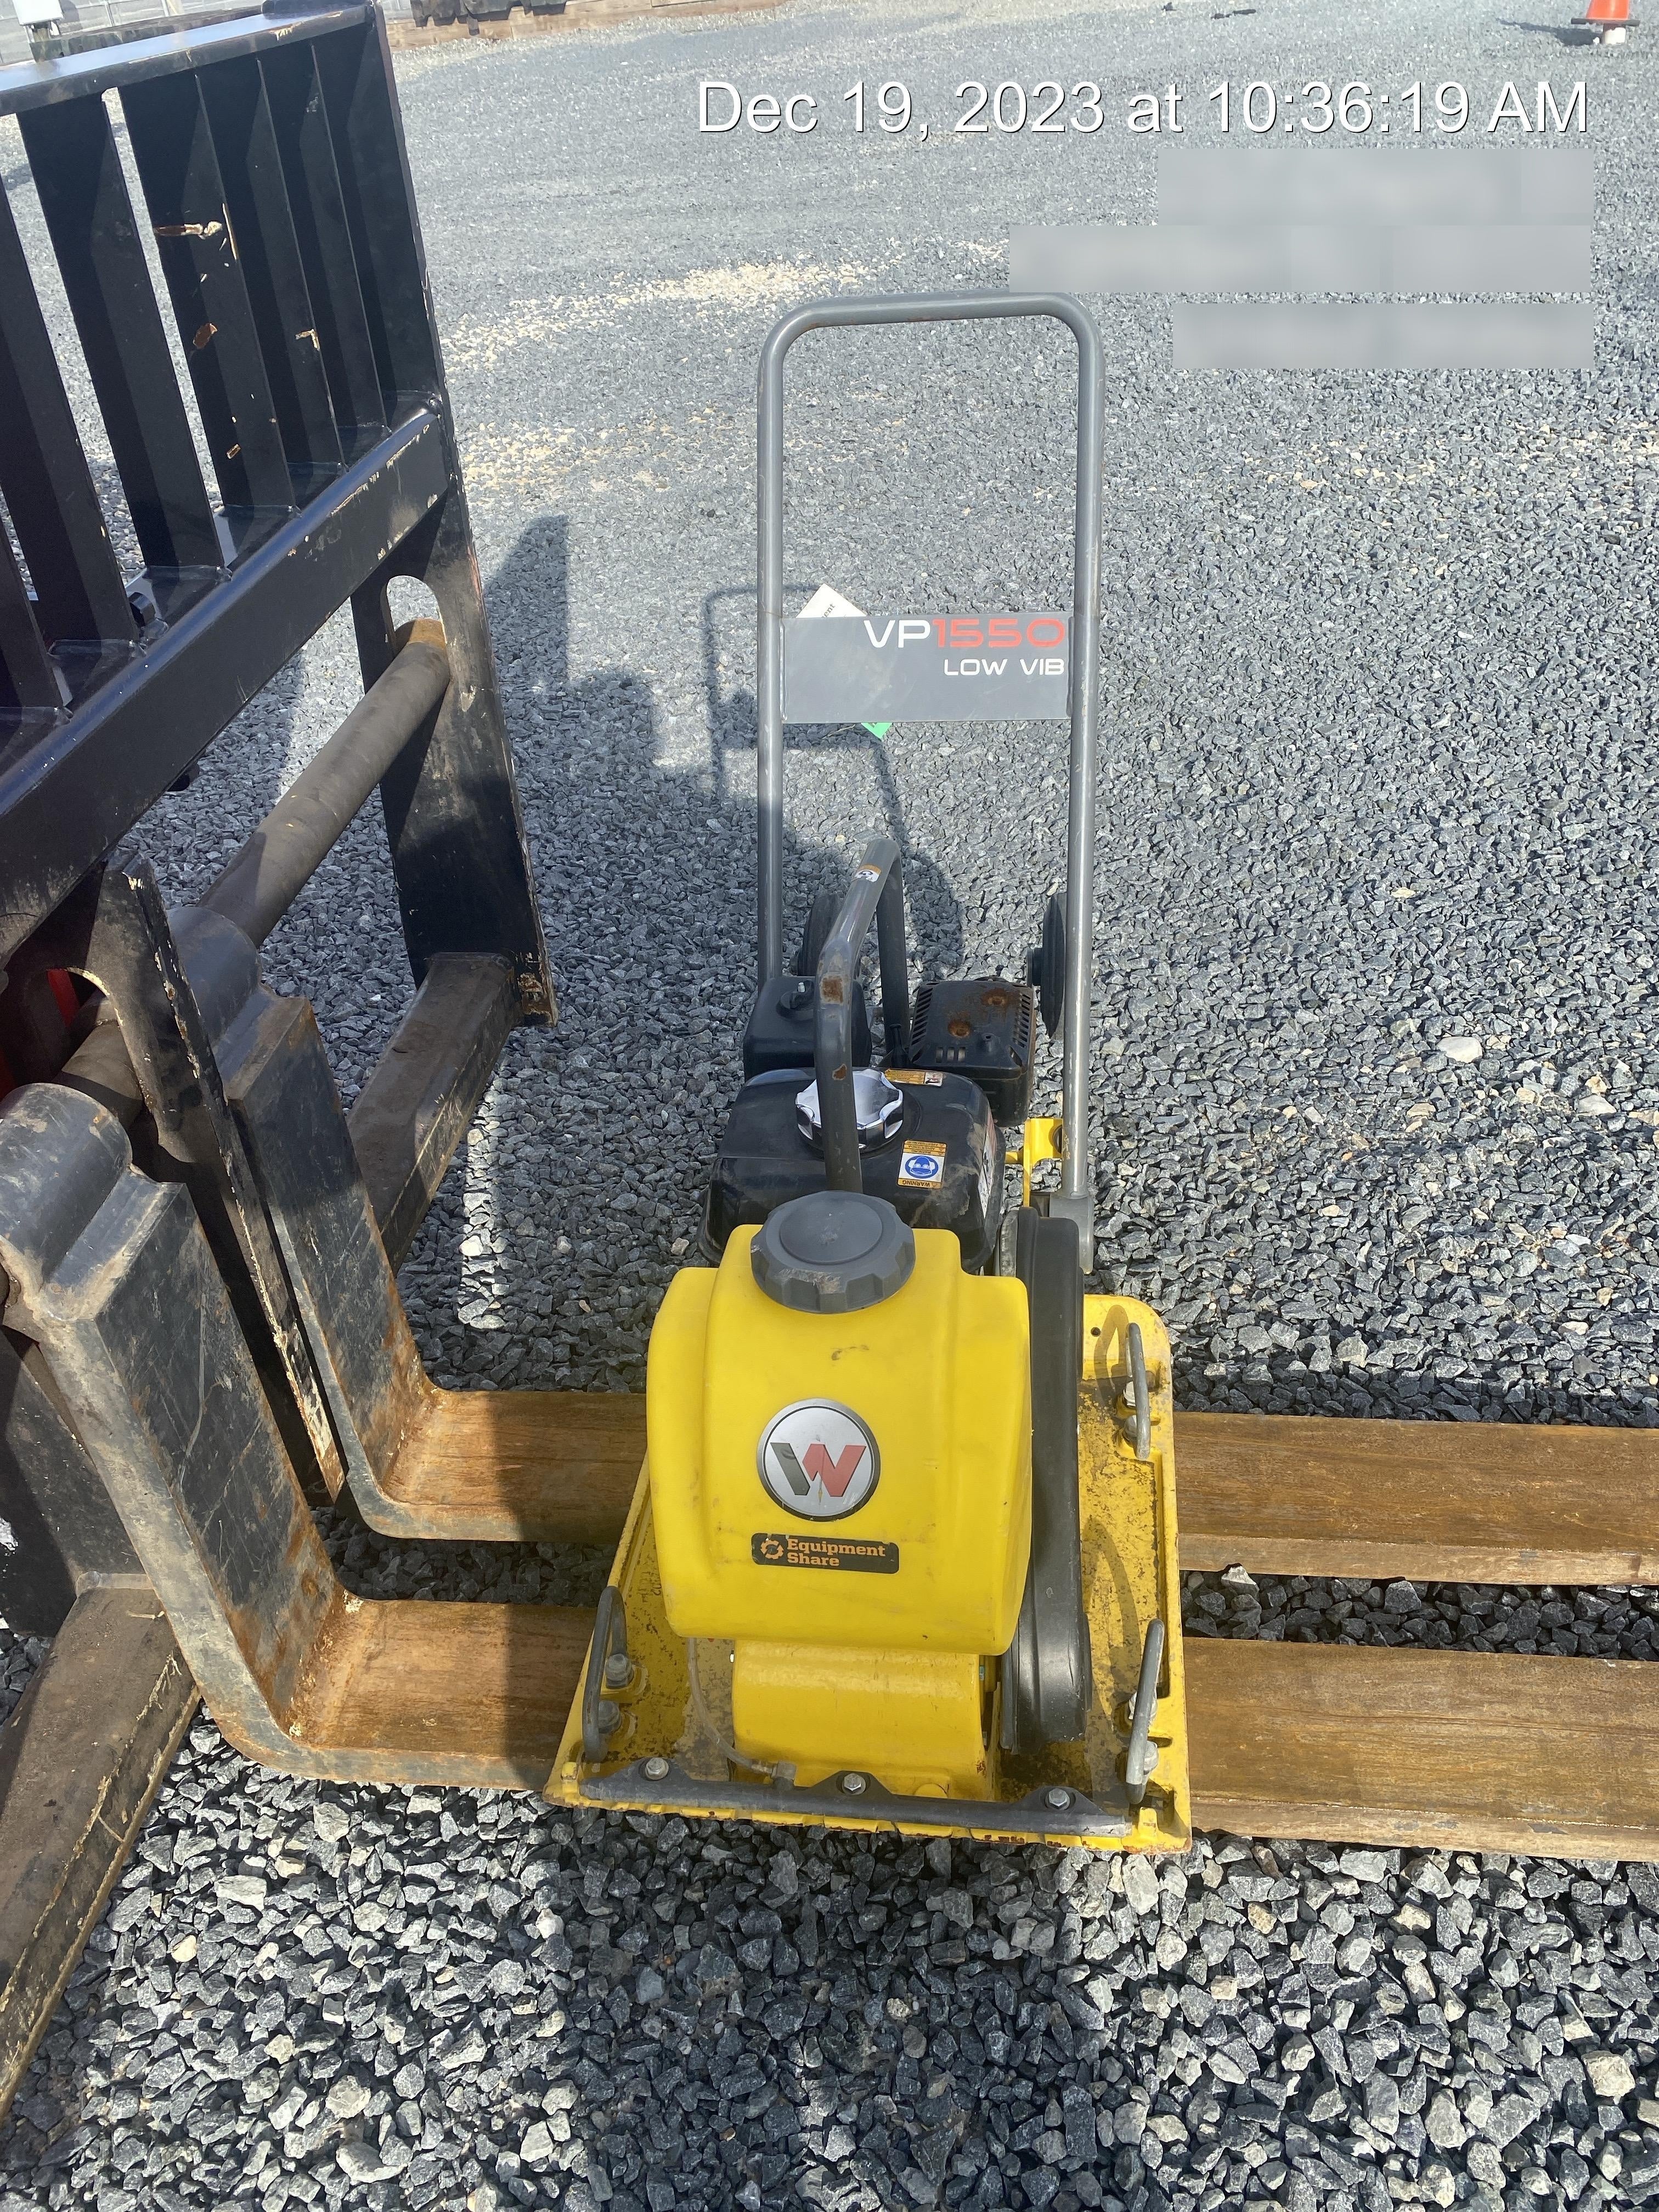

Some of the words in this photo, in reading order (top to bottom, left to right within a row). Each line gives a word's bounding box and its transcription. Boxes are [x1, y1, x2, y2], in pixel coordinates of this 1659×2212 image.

[864, 618, 1065, 648] VP1550
[944, 658, 1008, 676] LOW
[1019, 658, 1065, 676] VIB
[787, 1538, 886, 1557] Equipment
[787, 1552, 840, 1567] Share
